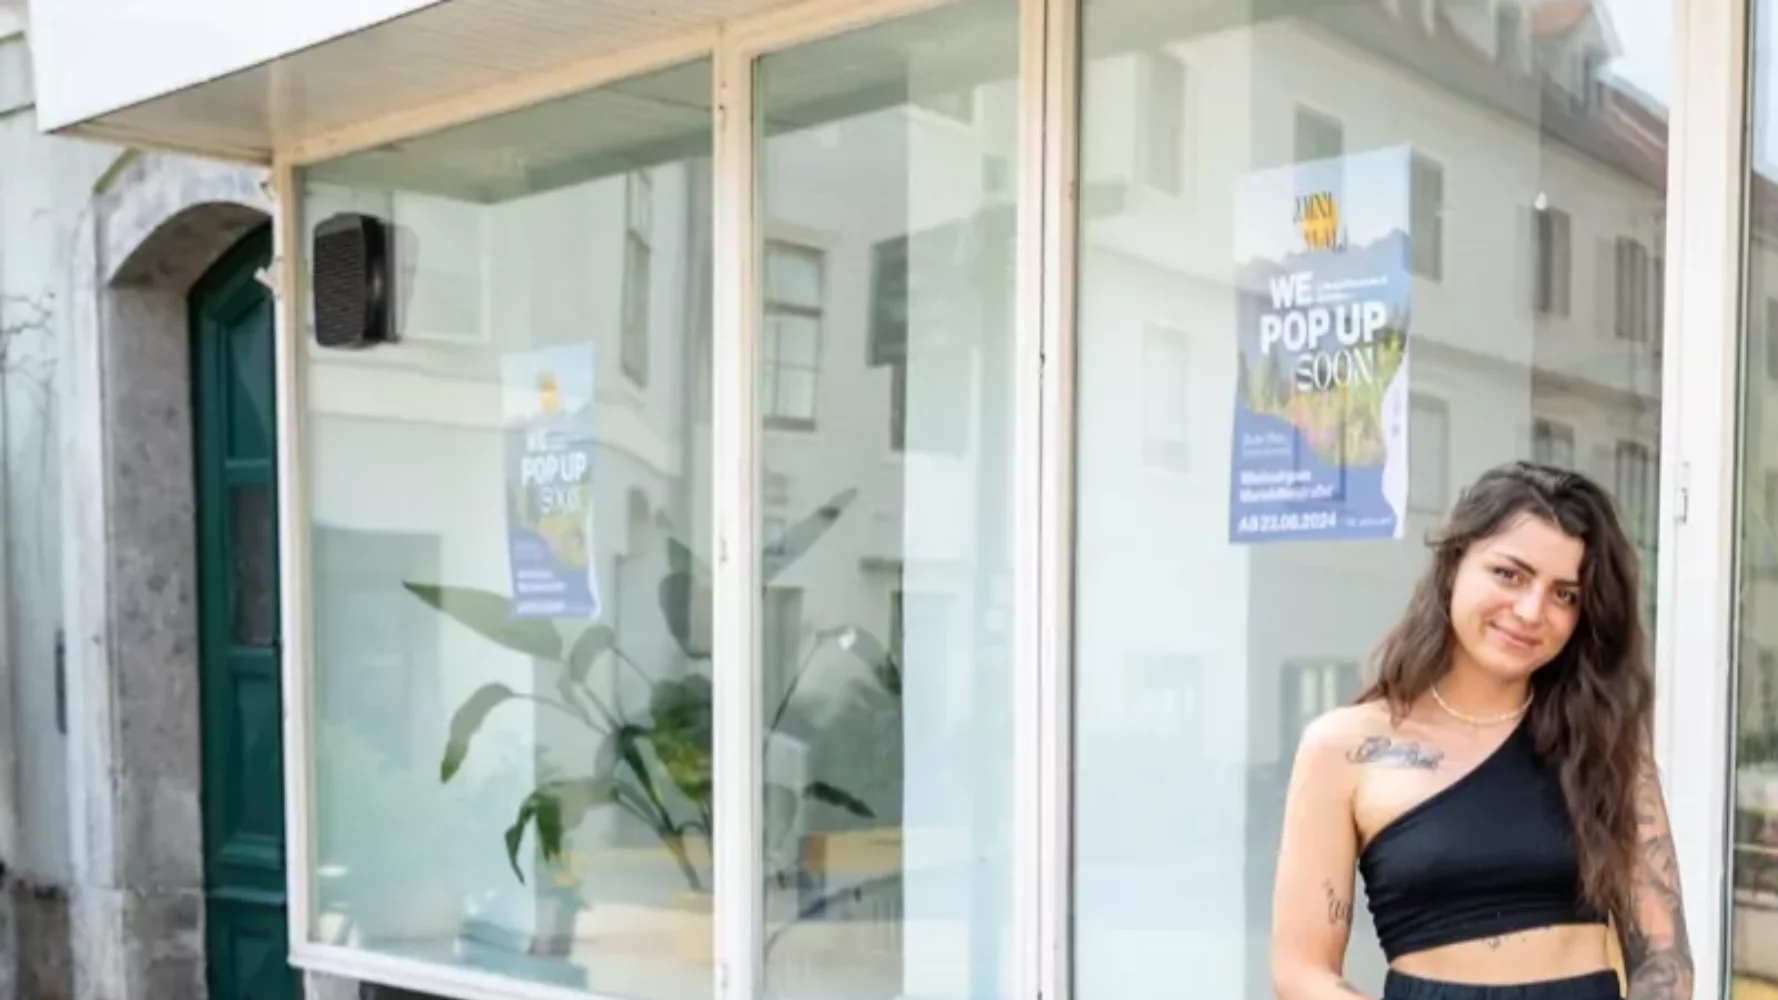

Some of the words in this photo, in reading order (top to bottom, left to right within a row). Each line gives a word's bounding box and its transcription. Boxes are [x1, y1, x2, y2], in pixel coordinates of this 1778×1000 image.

[1269, 271, 1313, 310] WE
[1260, 307, 1330, 355] POP
[1336, 301, 1386, 345] UP
[1296, 347, 1373, 391] SOON
[521, 454, 558, 488] POP
[560, 451, 586, 481] UP
